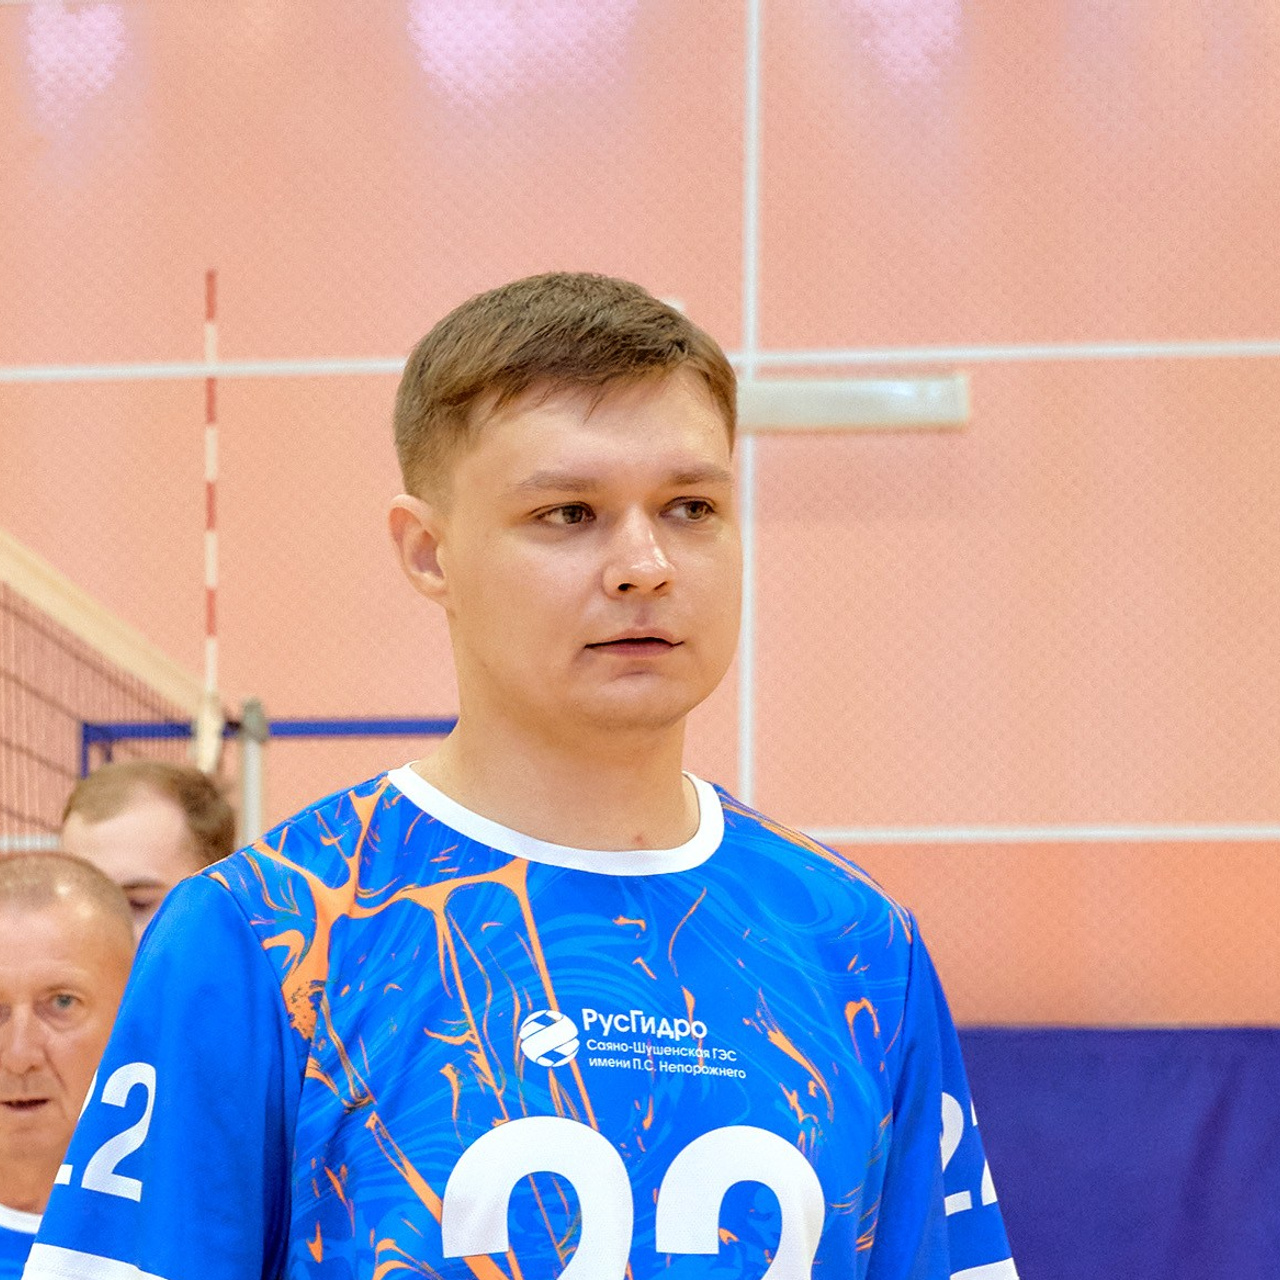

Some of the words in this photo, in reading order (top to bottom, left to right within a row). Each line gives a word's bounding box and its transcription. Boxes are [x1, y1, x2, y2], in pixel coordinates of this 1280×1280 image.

[581, 1008, 708, 1041] РусГидро
[586, 1039, 710, 1059] Саяно-Шушенская
[712, 1047, 737, 1062] ГЭС
[588, 1056, 631, 1070] имени
[632, 1057, 657, 1072] П.С.
[659, 1061, 747, 1080] Непорожнего
[54, 1062, 157, 1203] 2
